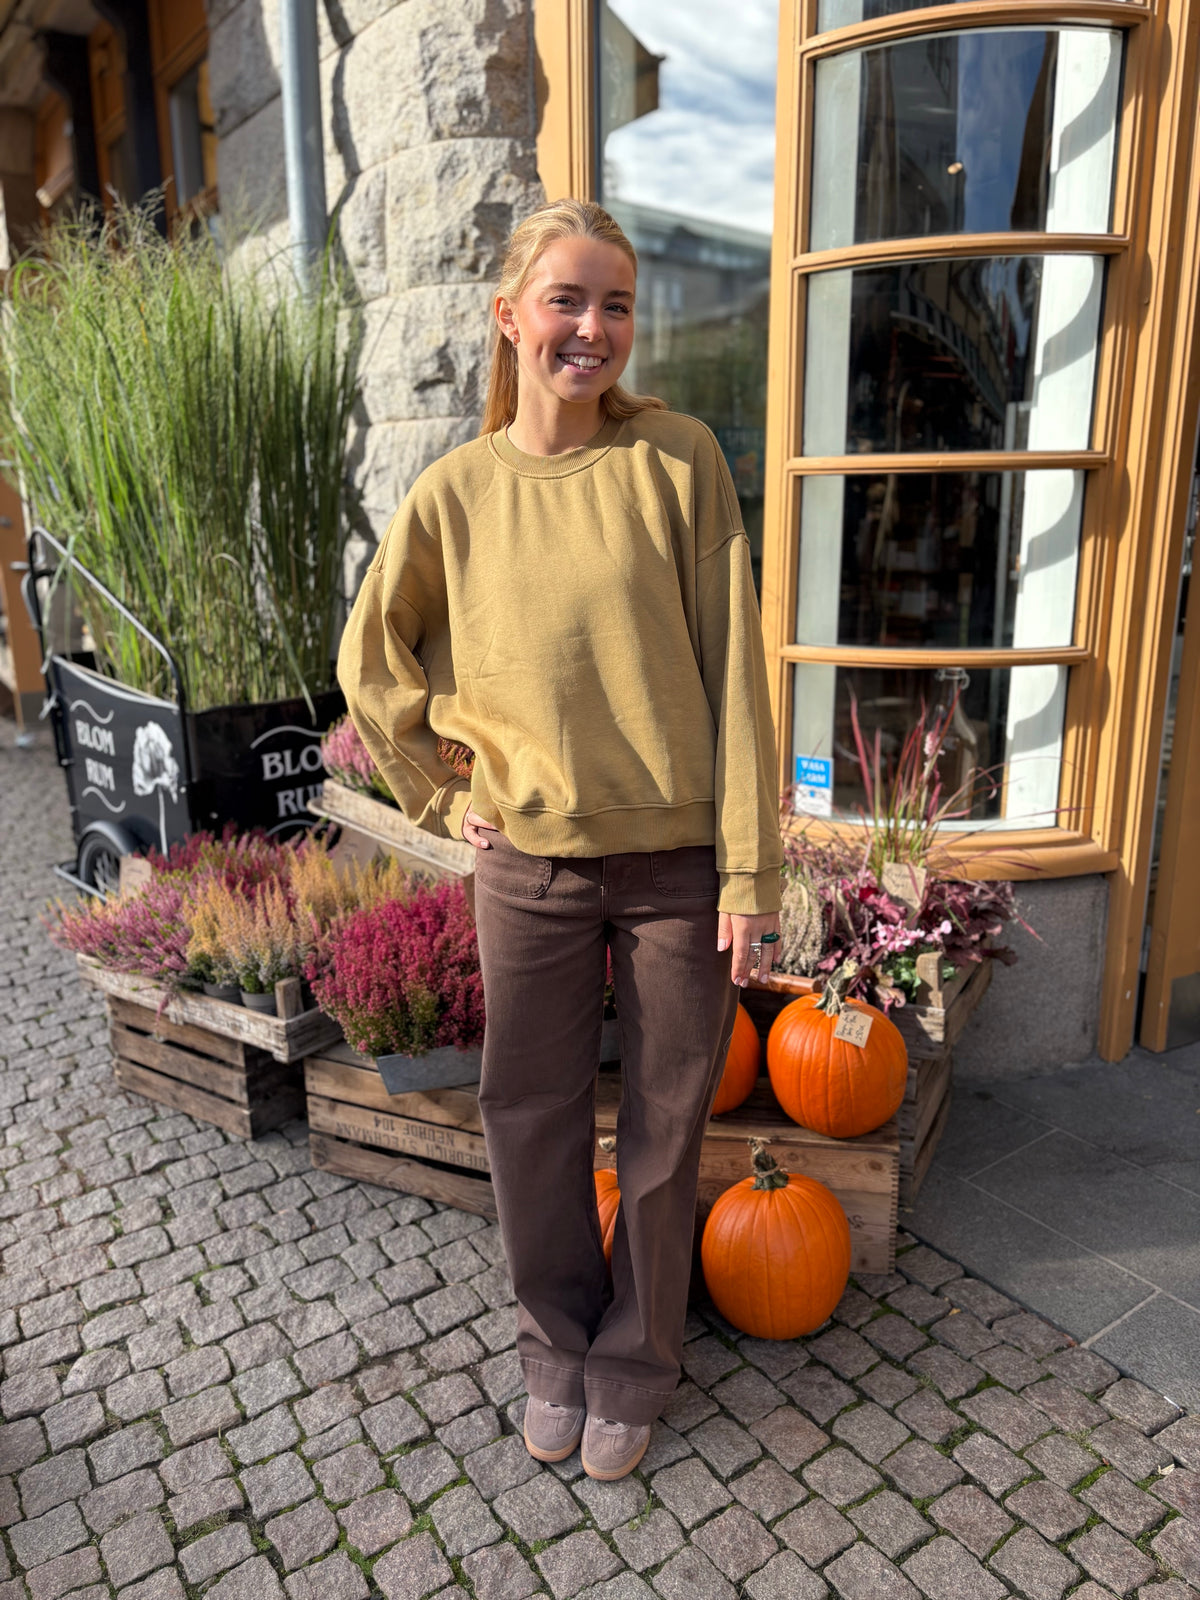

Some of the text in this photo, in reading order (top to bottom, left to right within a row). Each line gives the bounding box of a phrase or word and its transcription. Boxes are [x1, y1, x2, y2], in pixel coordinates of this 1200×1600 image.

[75, 719, 116, 757] BLOM
[261, 744, 323, 781] BLO
[276, 782, 324, 818] RU
[374, 1115, 455, 1147] NEUHOF 104
